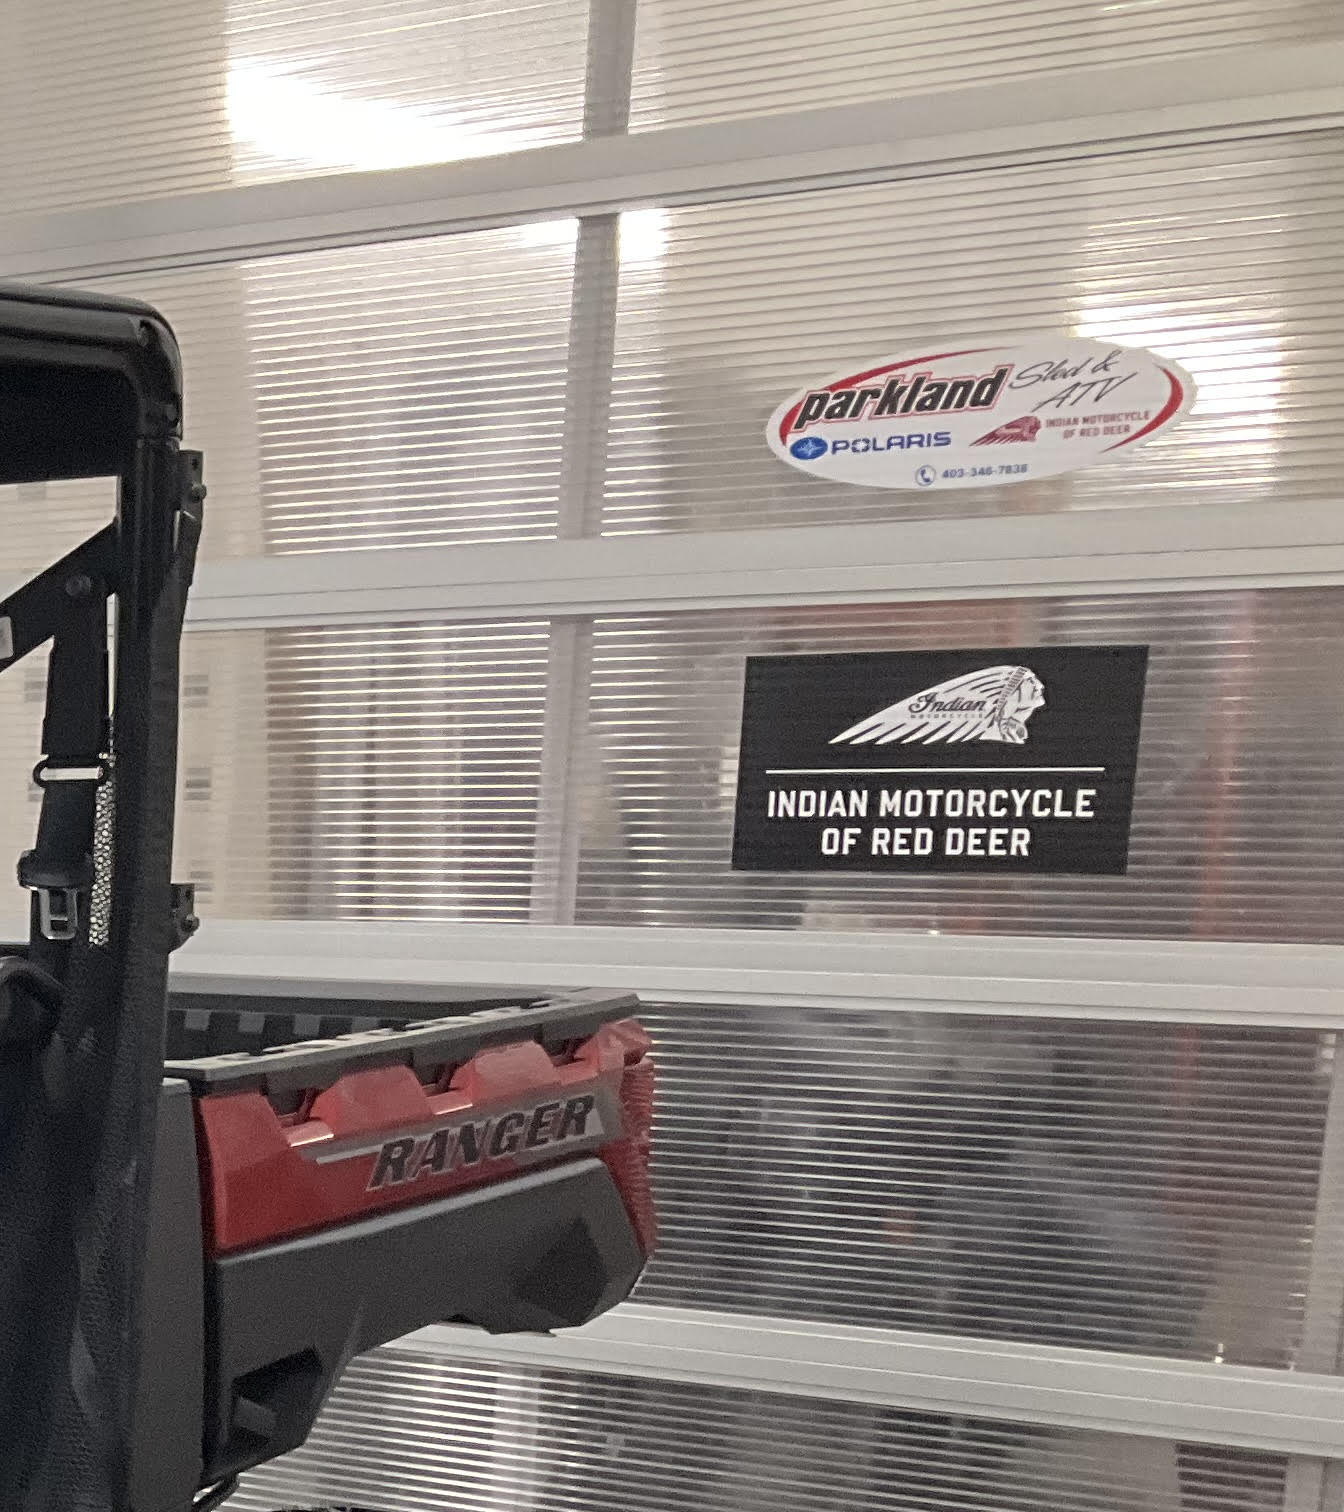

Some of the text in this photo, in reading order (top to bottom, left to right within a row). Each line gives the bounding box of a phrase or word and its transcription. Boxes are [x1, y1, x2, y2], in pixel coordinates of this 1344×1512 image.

[1008, 349, 1123, 389] Sled &
[791, 365, 1013, 432] parkland
[1030, 371, 1138, 412] ATV
[1046, 410, 1151, 427] INDIAN MOTORCYCLE
[1063, 424, 1130, 439] OF RED DEER
[831, 431, 951, 455] POLARIS
[908, 691, 987, 713] Indian
[767, 788, 1097, 818] INDIAN MOTORCYCLE
[821, 827, 1031, 857] OF RED DEER
[366, 1094, 597, 1192] RANGER
